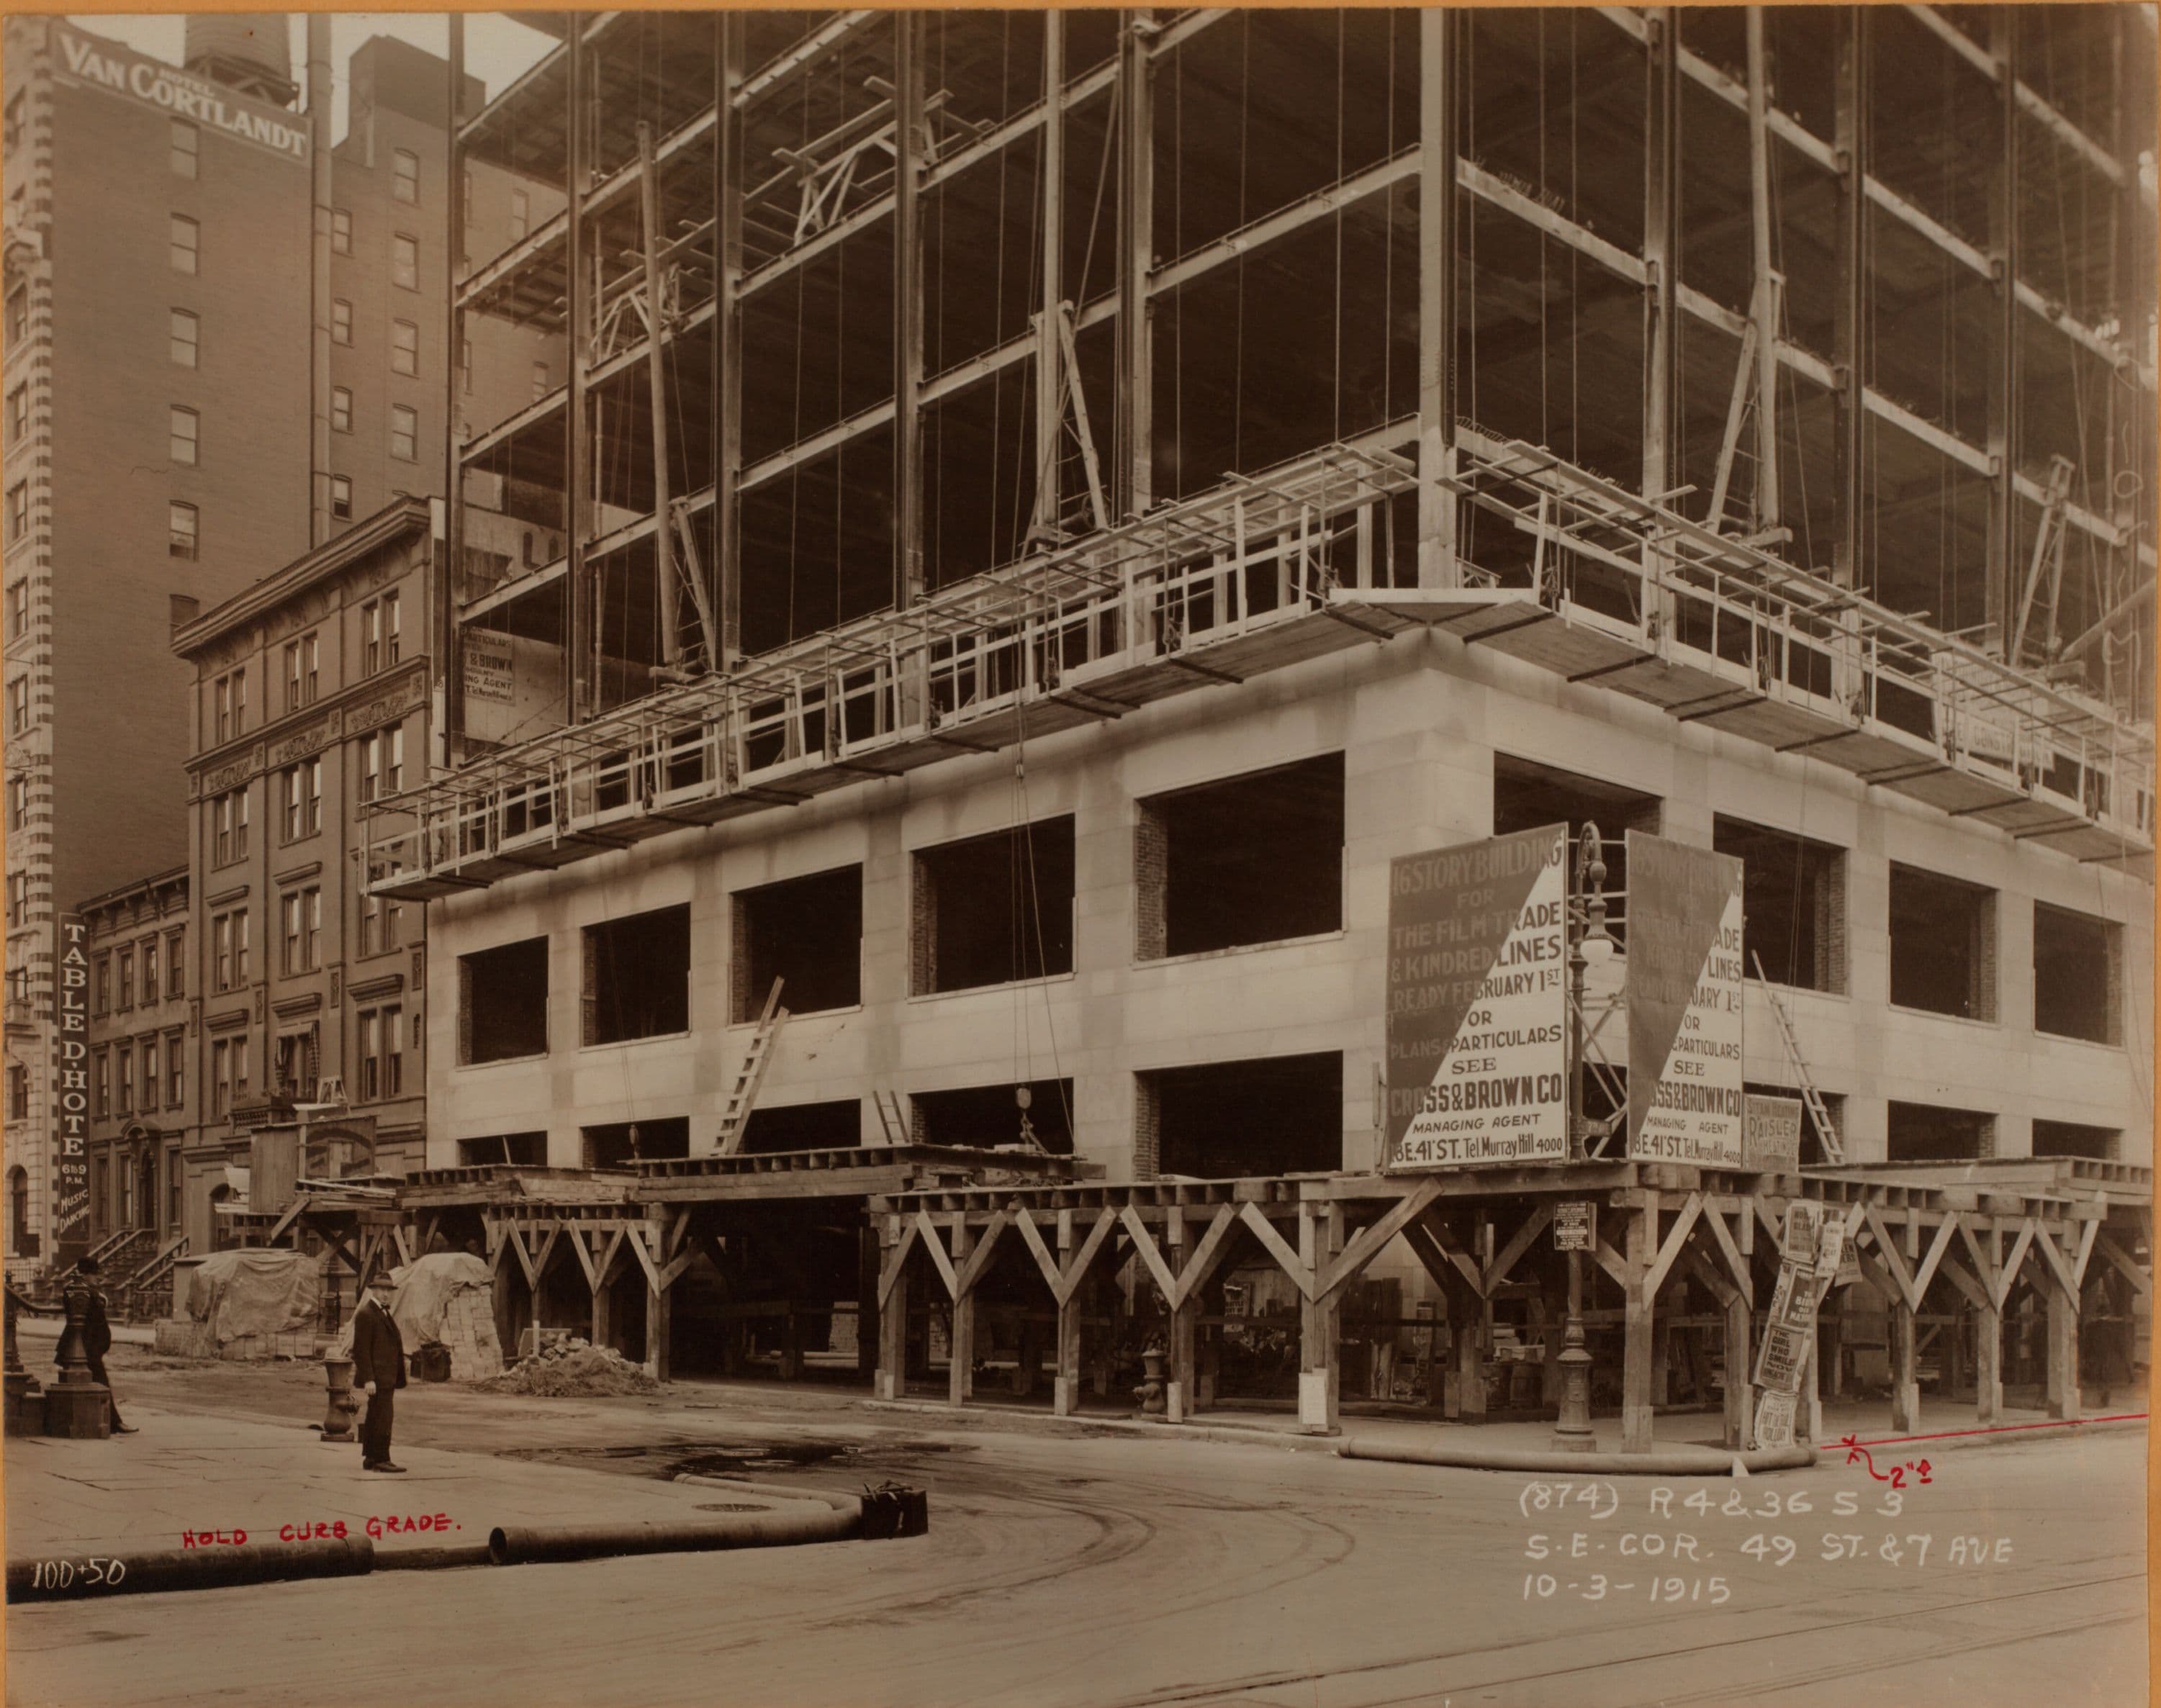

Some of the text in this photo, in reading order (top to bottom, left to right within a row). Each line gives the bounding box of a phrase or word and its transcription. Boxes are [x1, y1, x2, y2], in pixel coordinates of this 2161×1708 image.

[60, 34, 306, 156] VAN CORTLANDT
[479, 654, 513, 672] BROWN
[465, 674, 513, 690] ING AGENT
[1476, 835, 1563, 884] BUILDING
[1393, 902, 1561, 950] THE FILM TRADE
[1405, 945, 1493, 981] KINDRED
[1497, 935, 1561, 967] LINES
[1707, 955, 1741, 982] LINES
[62, 924, 88, 1032] TABLE
[1452, 972, 1534, 1000] FEBRUARY
[1458, 1011, 1492, 1027] OR
[1680, 1013, 1700, 1031] OR
[1391, 1039, 1441, 1059] PLANS
[1451, 1025, 1562, 1053] PARTICULARS
[1679, 1036, 1740, 1060] PARTICULARS
[1451, 1057, 1497, 1075] SEE
[1674, 1059, 1705, 1076] SEE
[1538, 1073, 1562, 1103] CO
[1727, 1089, 1741, 1117] CO
[1412, 1113, 1542, 1134] MANAGING AGENT
[1647, 1116, 1729, 1135] MANAGING AGENT
[1749, 1116, 1797, 1147] RAISLER
[1437, 1139, 1461, 1160] ST.
[1481, 1137, 1517, 1158] Murray
[1518, 1134, 1534, 1154] Hill
[1536, 1137, 1563, 1154] 4000
[1724, 1149, 1741, 1164] 4000
[61, 1188, 89, 1214] MUSIC
[60, 1205, 90, 1234] DANCING
[1772, 1345, 1790, 1356] WHO
[1773, 1336, 1790, 1347] GIRL
